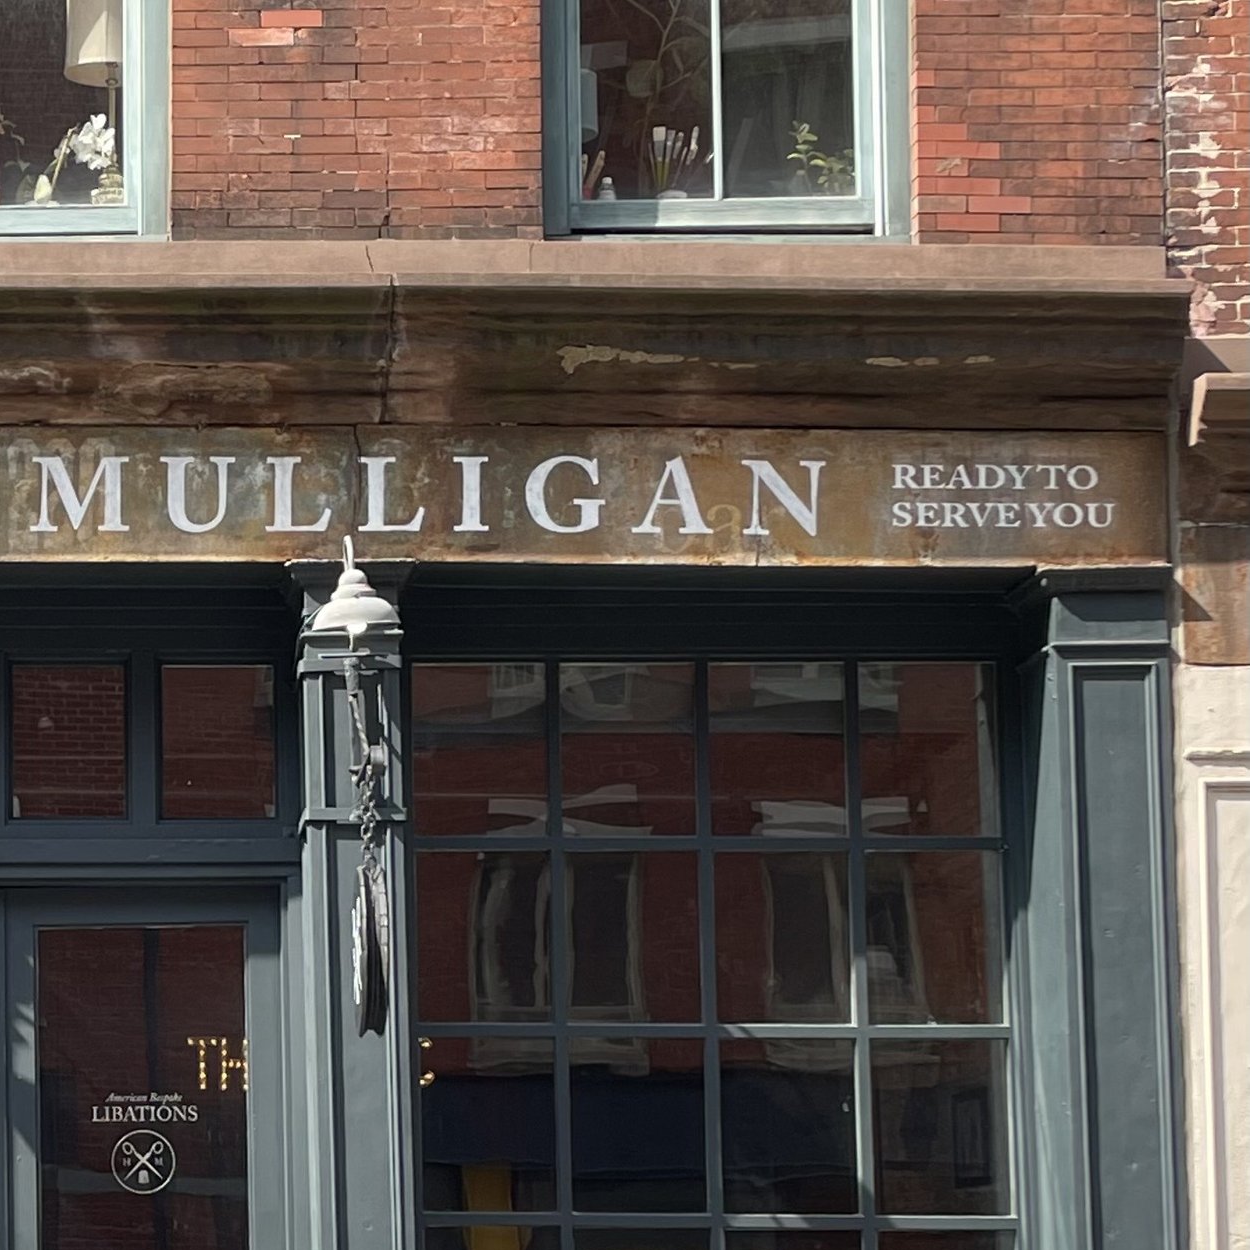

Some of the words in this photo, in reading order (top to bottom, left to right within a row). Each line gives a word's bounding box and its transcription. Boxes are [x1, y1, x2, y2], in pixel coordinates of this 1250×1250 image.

[891, 463, 1035, 490] READY
[1036, 463, 1099, 490] TO
[29, 454, 827, 537] MULLIGAN
[891, 501, 1022, 528] SERVE
[1024, 501, 1117, 528] YOU
[105, 1091, 148, 1103] American
[92, 1104, 199, 1122] LIBATIONS
